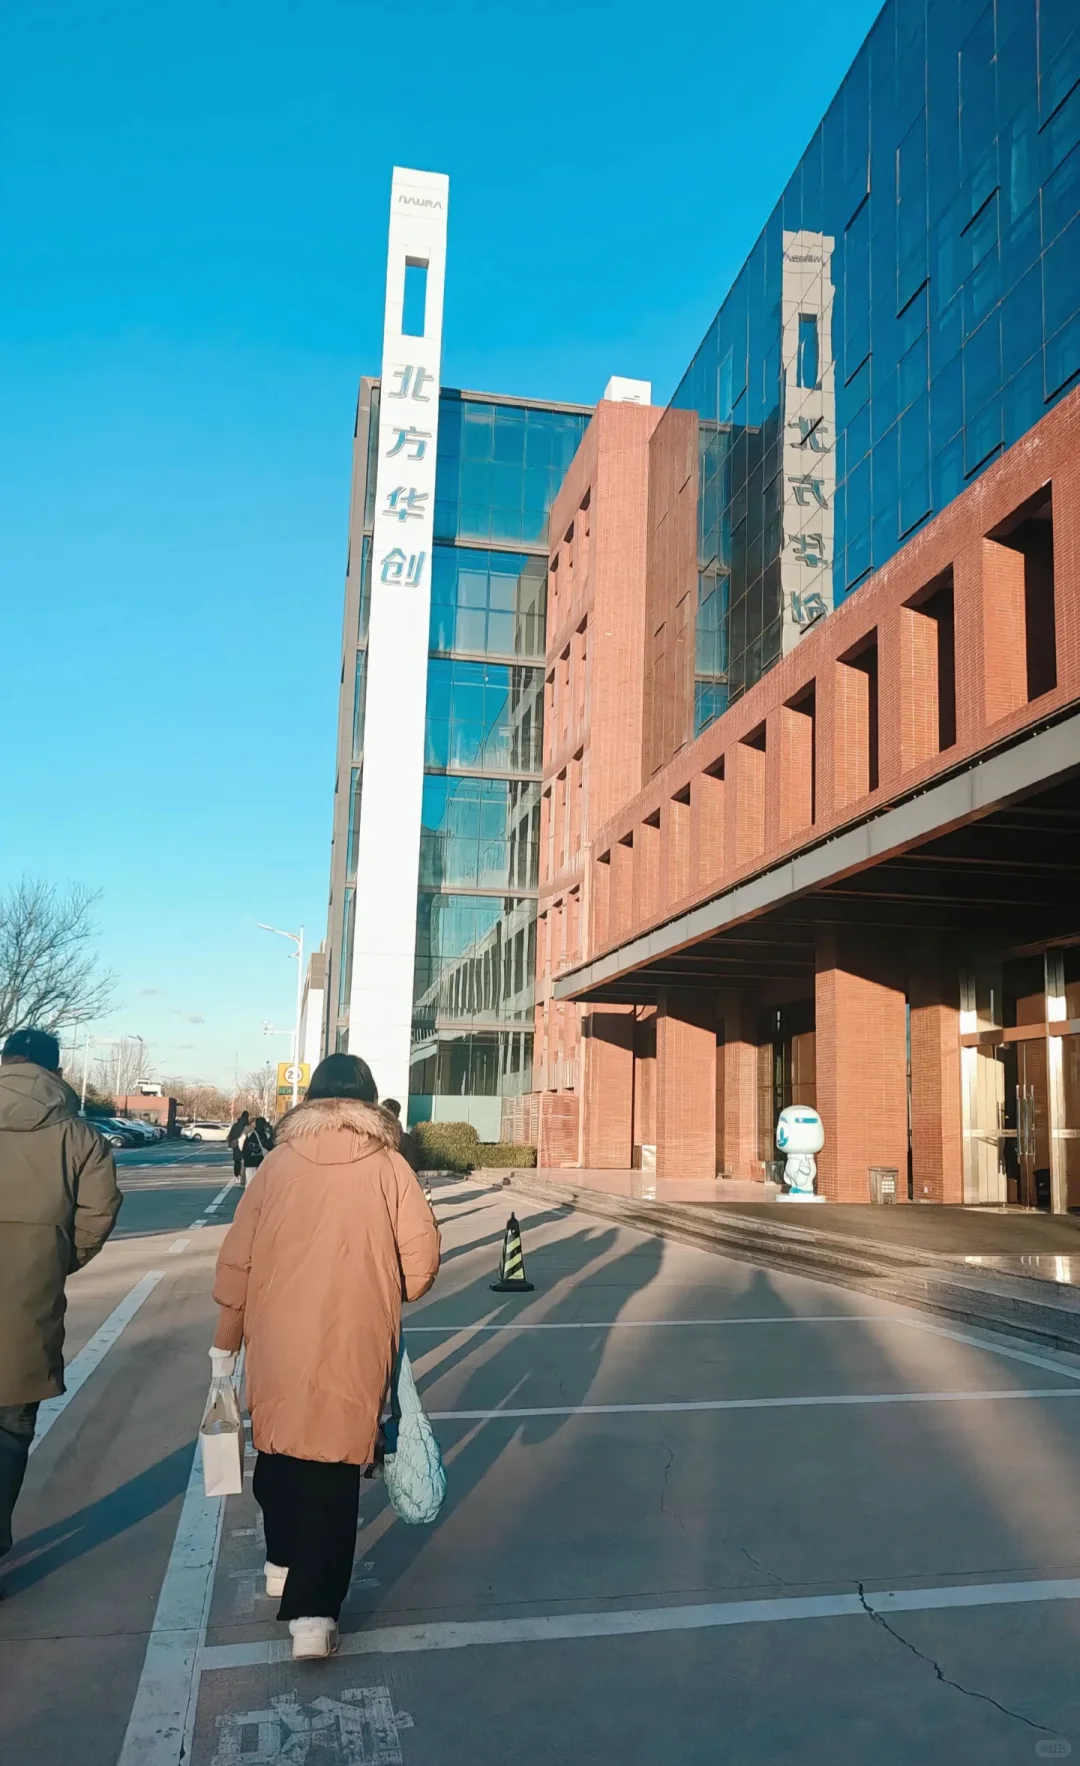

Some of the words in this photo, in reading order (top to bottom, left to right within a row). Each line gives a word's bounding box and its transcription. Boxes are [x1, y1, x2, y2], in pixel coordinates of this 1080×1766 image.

[398, 194, 442, 210] NAURA
[379, 364, 434, 588] 北方华创
